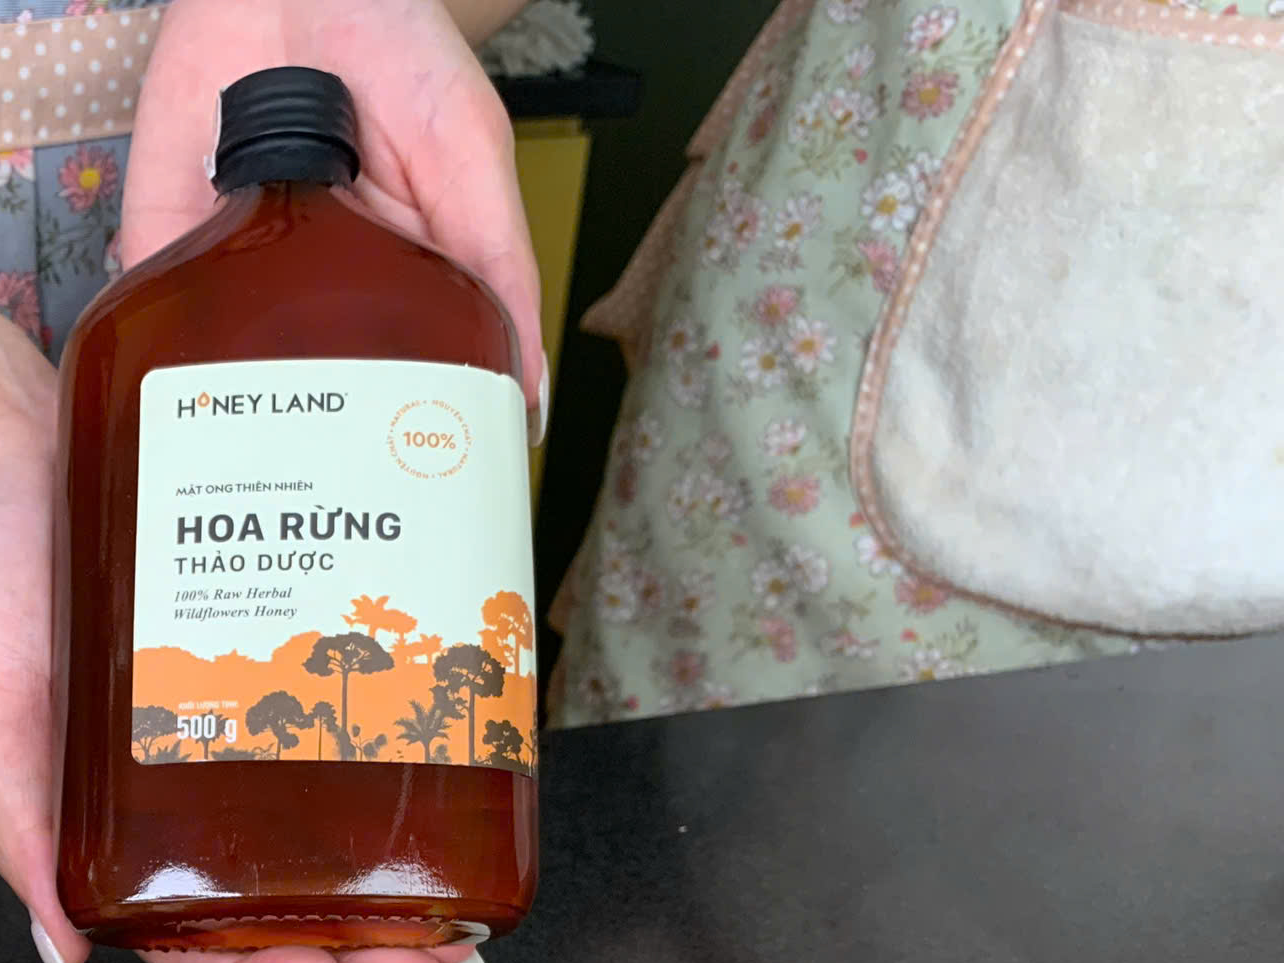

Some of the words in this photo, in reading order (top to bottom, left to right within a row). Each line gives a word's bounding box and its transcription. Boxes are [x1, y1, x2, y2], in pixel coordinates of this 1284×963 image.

[177, 391, 263, 419] HONEY
[271, 392, 345, 413] LAND
[403, 431, 456, 450] 100%
[205, 483, 233, 495] ONG
[235, 480, 272, 493] THIÊN
[274, 479, 313, 492] NHIÊN
[176, 512, 265, 545] HOA
[279, 504, 402, 541] RỪNG
[174, 550, 246, 575] THẢO
[257, 550, 335, 575] DƯỢC
[174, 590, 209, 603] 100%
[213, 588, 242, 601] Raw
[246, 586, 293, 600] Herbal
[174, 606, 250, 622] Wildflowers
[254, 605, 298, 620] Honey
[176, 714, 217, 740] 500
[223, 718, 238, 743] g
